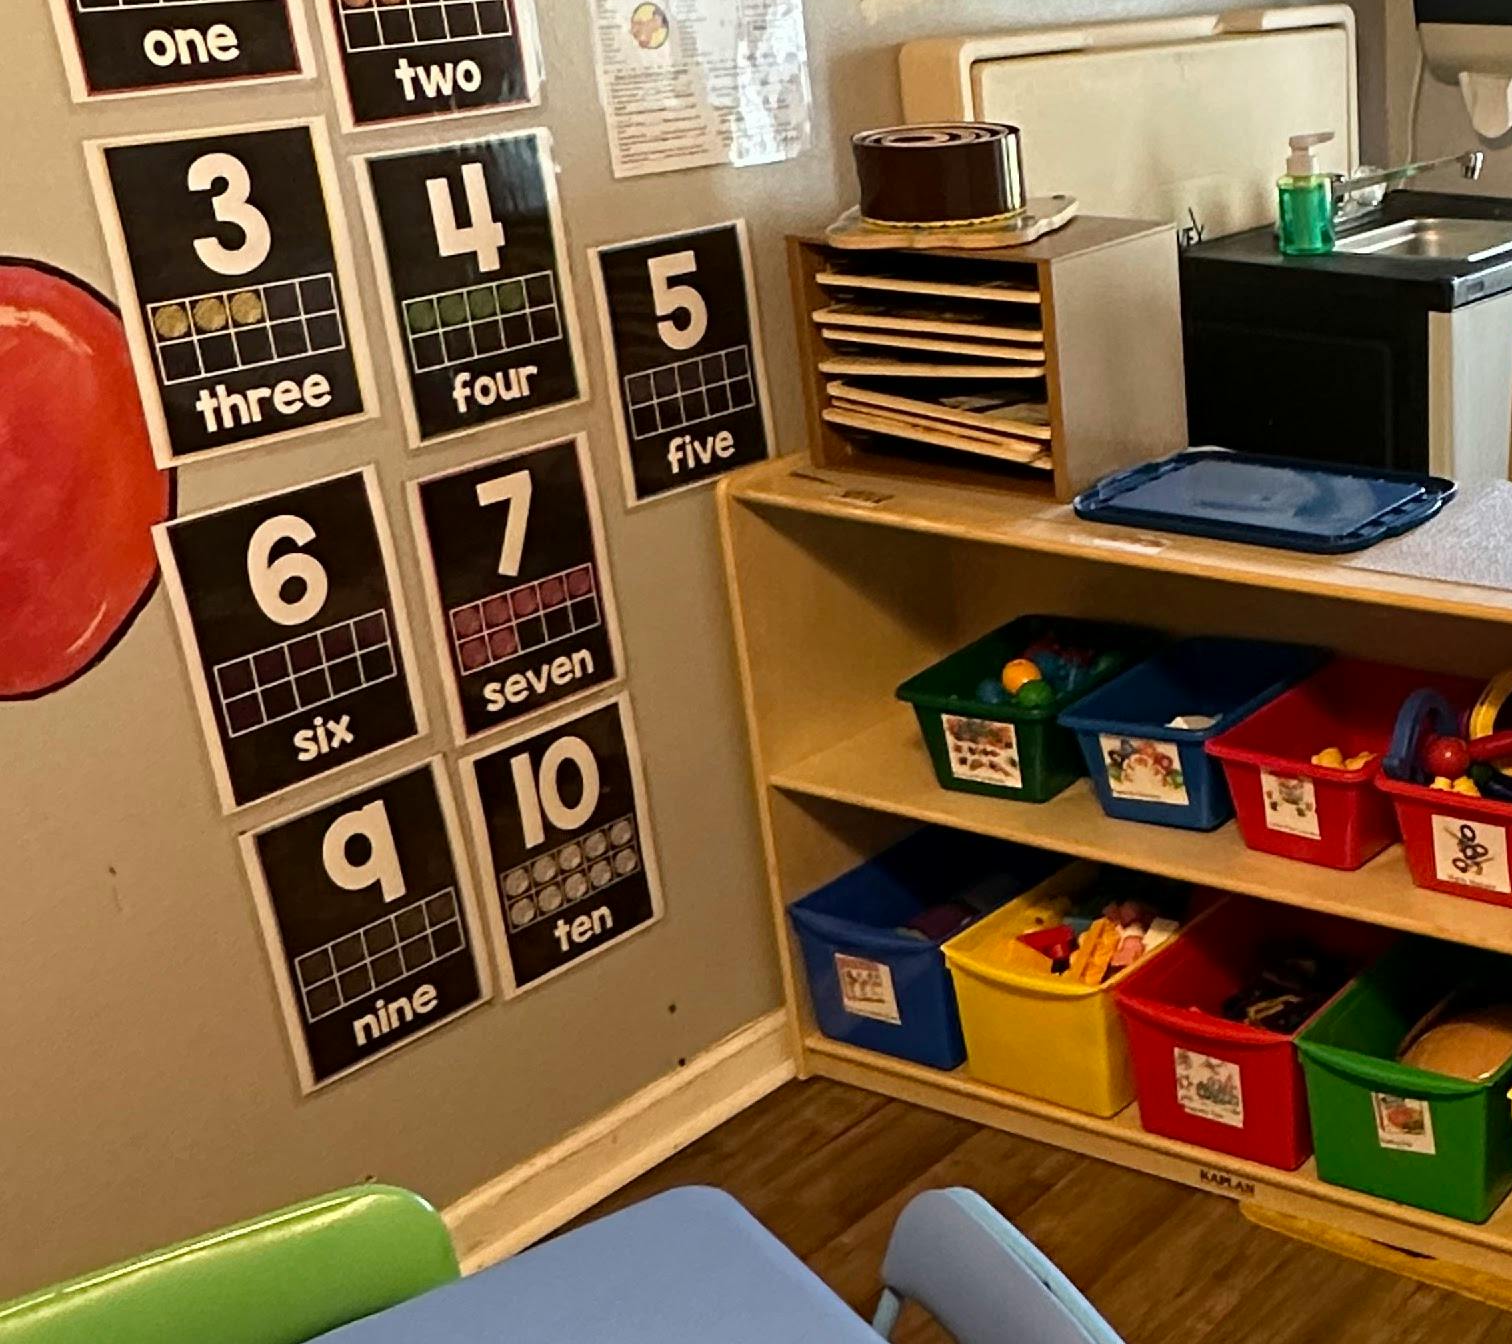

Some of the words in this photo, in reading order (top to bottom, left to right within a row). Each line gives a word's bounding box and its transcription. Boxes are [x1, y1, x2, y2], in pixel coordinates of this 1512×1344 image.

[144, 23, 240, 67] one
[395, 56, 481, 101] two
[187, 152, 271, 276] 3
[427, 163, 505, 271] 4
[648, 250, 708, 350] 5
[195, 372, 332, 433] three
[453, 362, 538, 414] four
[666, 428, 734, 473] five
[476, 469, 533, 578] 7
[248, 515, 328, 626] 6
[482, 649, 594, 714] seven
[293, 712, 354, 761] six
[510, 735, 600, 848] 10
[320, 803, 406, 903] 9
[552, 903, 614, 953] ten
[352, 981, 439, 1049] nine
[1200, 1169, 1255, 1193] KAPLAN
